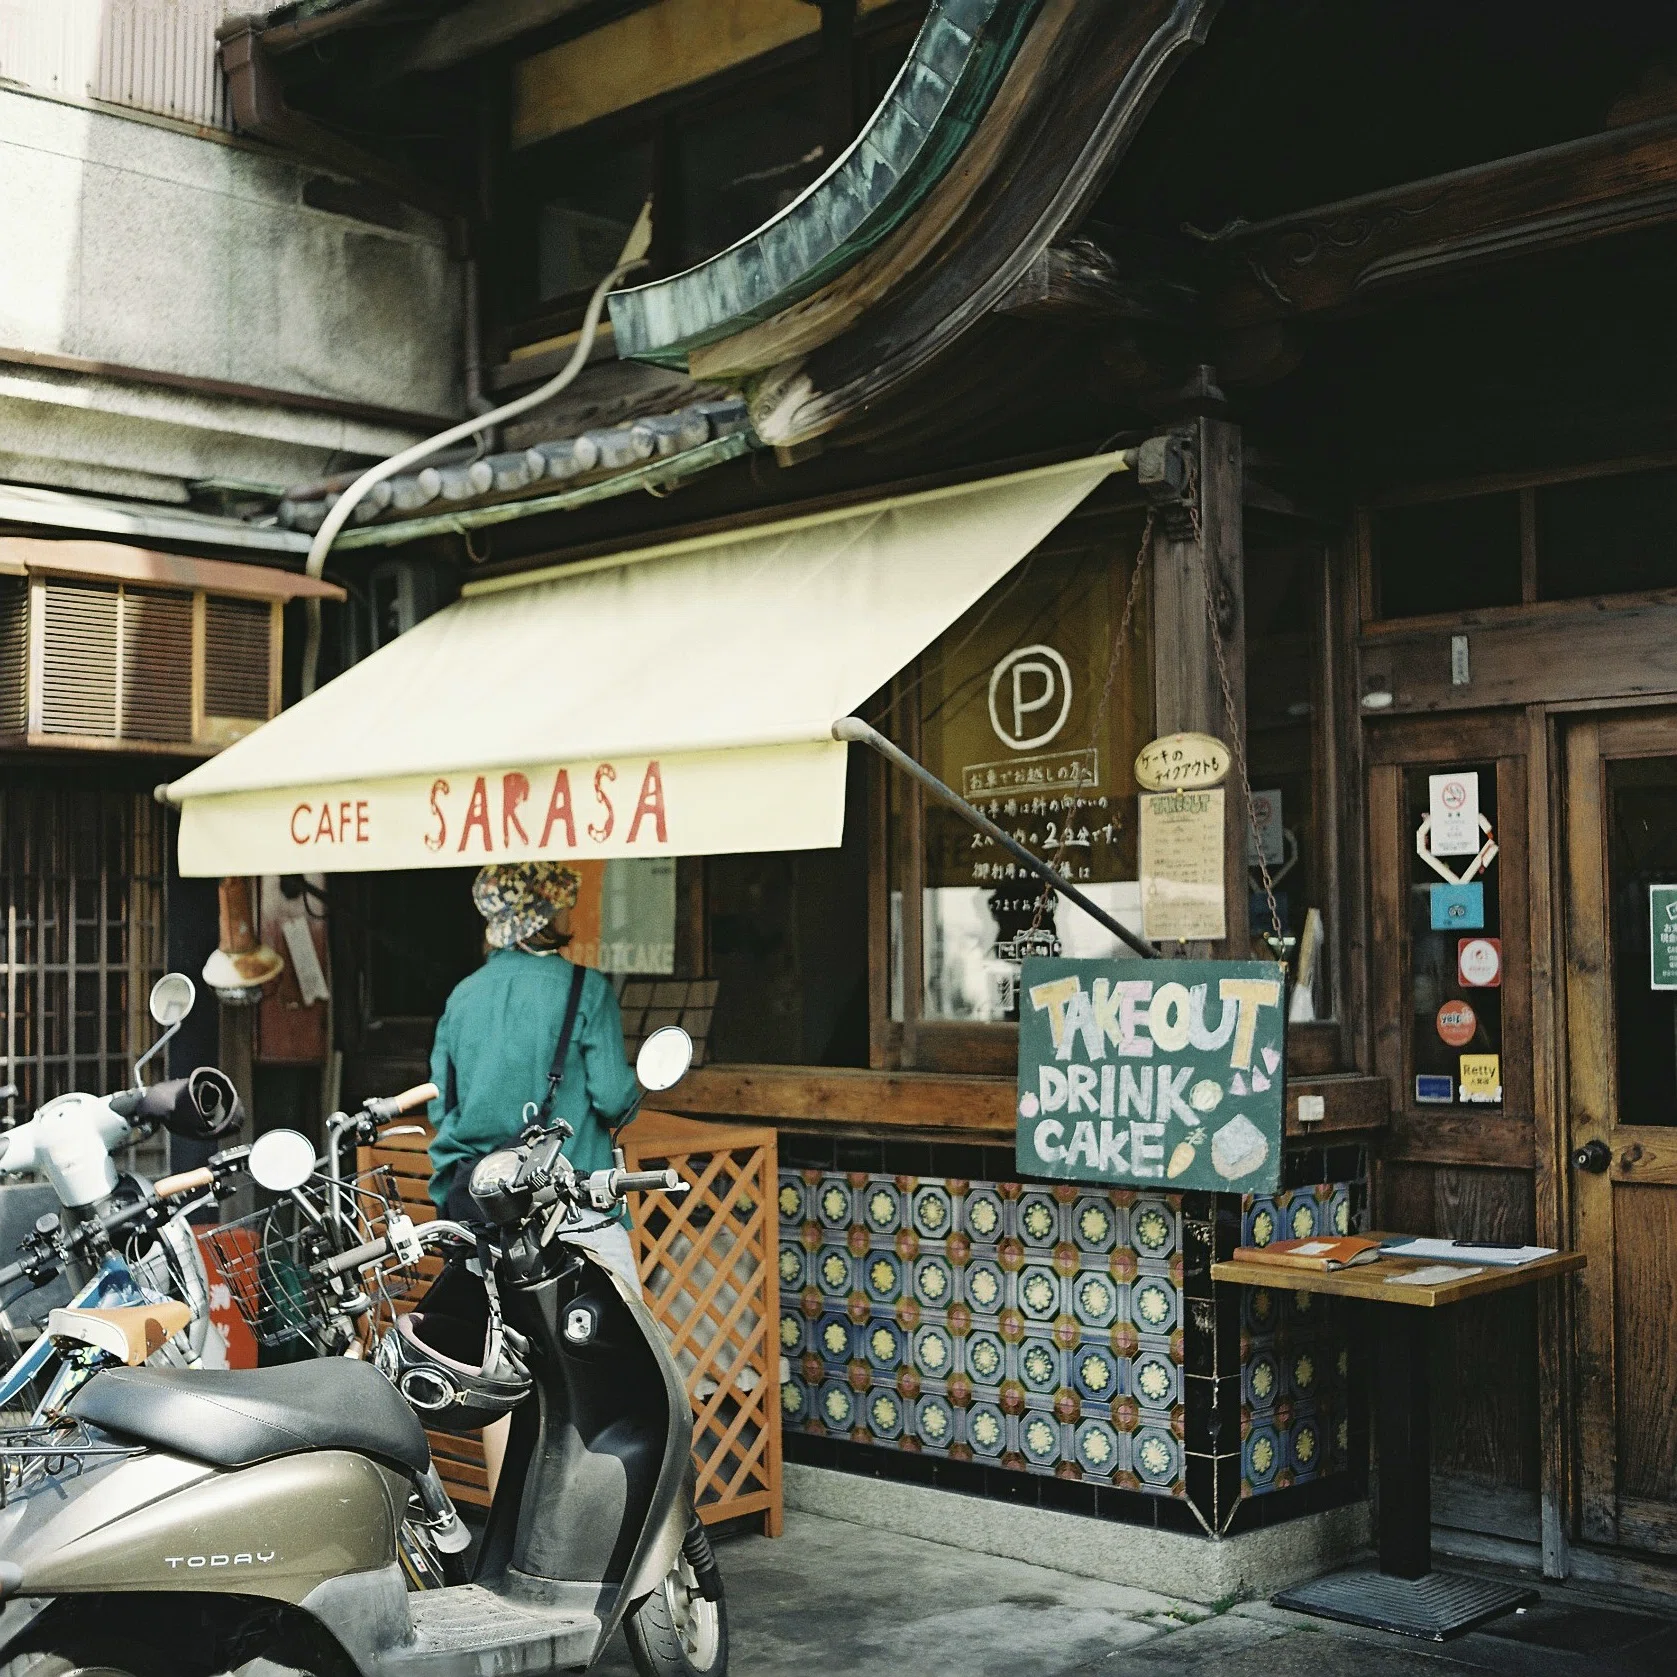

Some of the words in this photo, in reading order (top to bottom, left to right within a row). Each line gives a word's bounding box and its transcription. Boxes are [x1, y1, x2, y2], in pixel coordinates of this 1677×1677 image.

[1012, 661, 1055, 738] P
[1140, 749, 1184, 770] ケーキの
[1155, 756, 1220, 786] テイクアウトも
[290, 800, 371, 845] CAFE
[424, 760, 669, 853] SARASA
[1028, 975, 1281, 1070] TAKEOUT
[1038, 1064, 1201, 1127] DRINK
[1462, 1064, 1497, 1078] Retty
[1033, 1119, 1165, 1178] CAKE
[164, 1551, 275, 1569] TODAY
